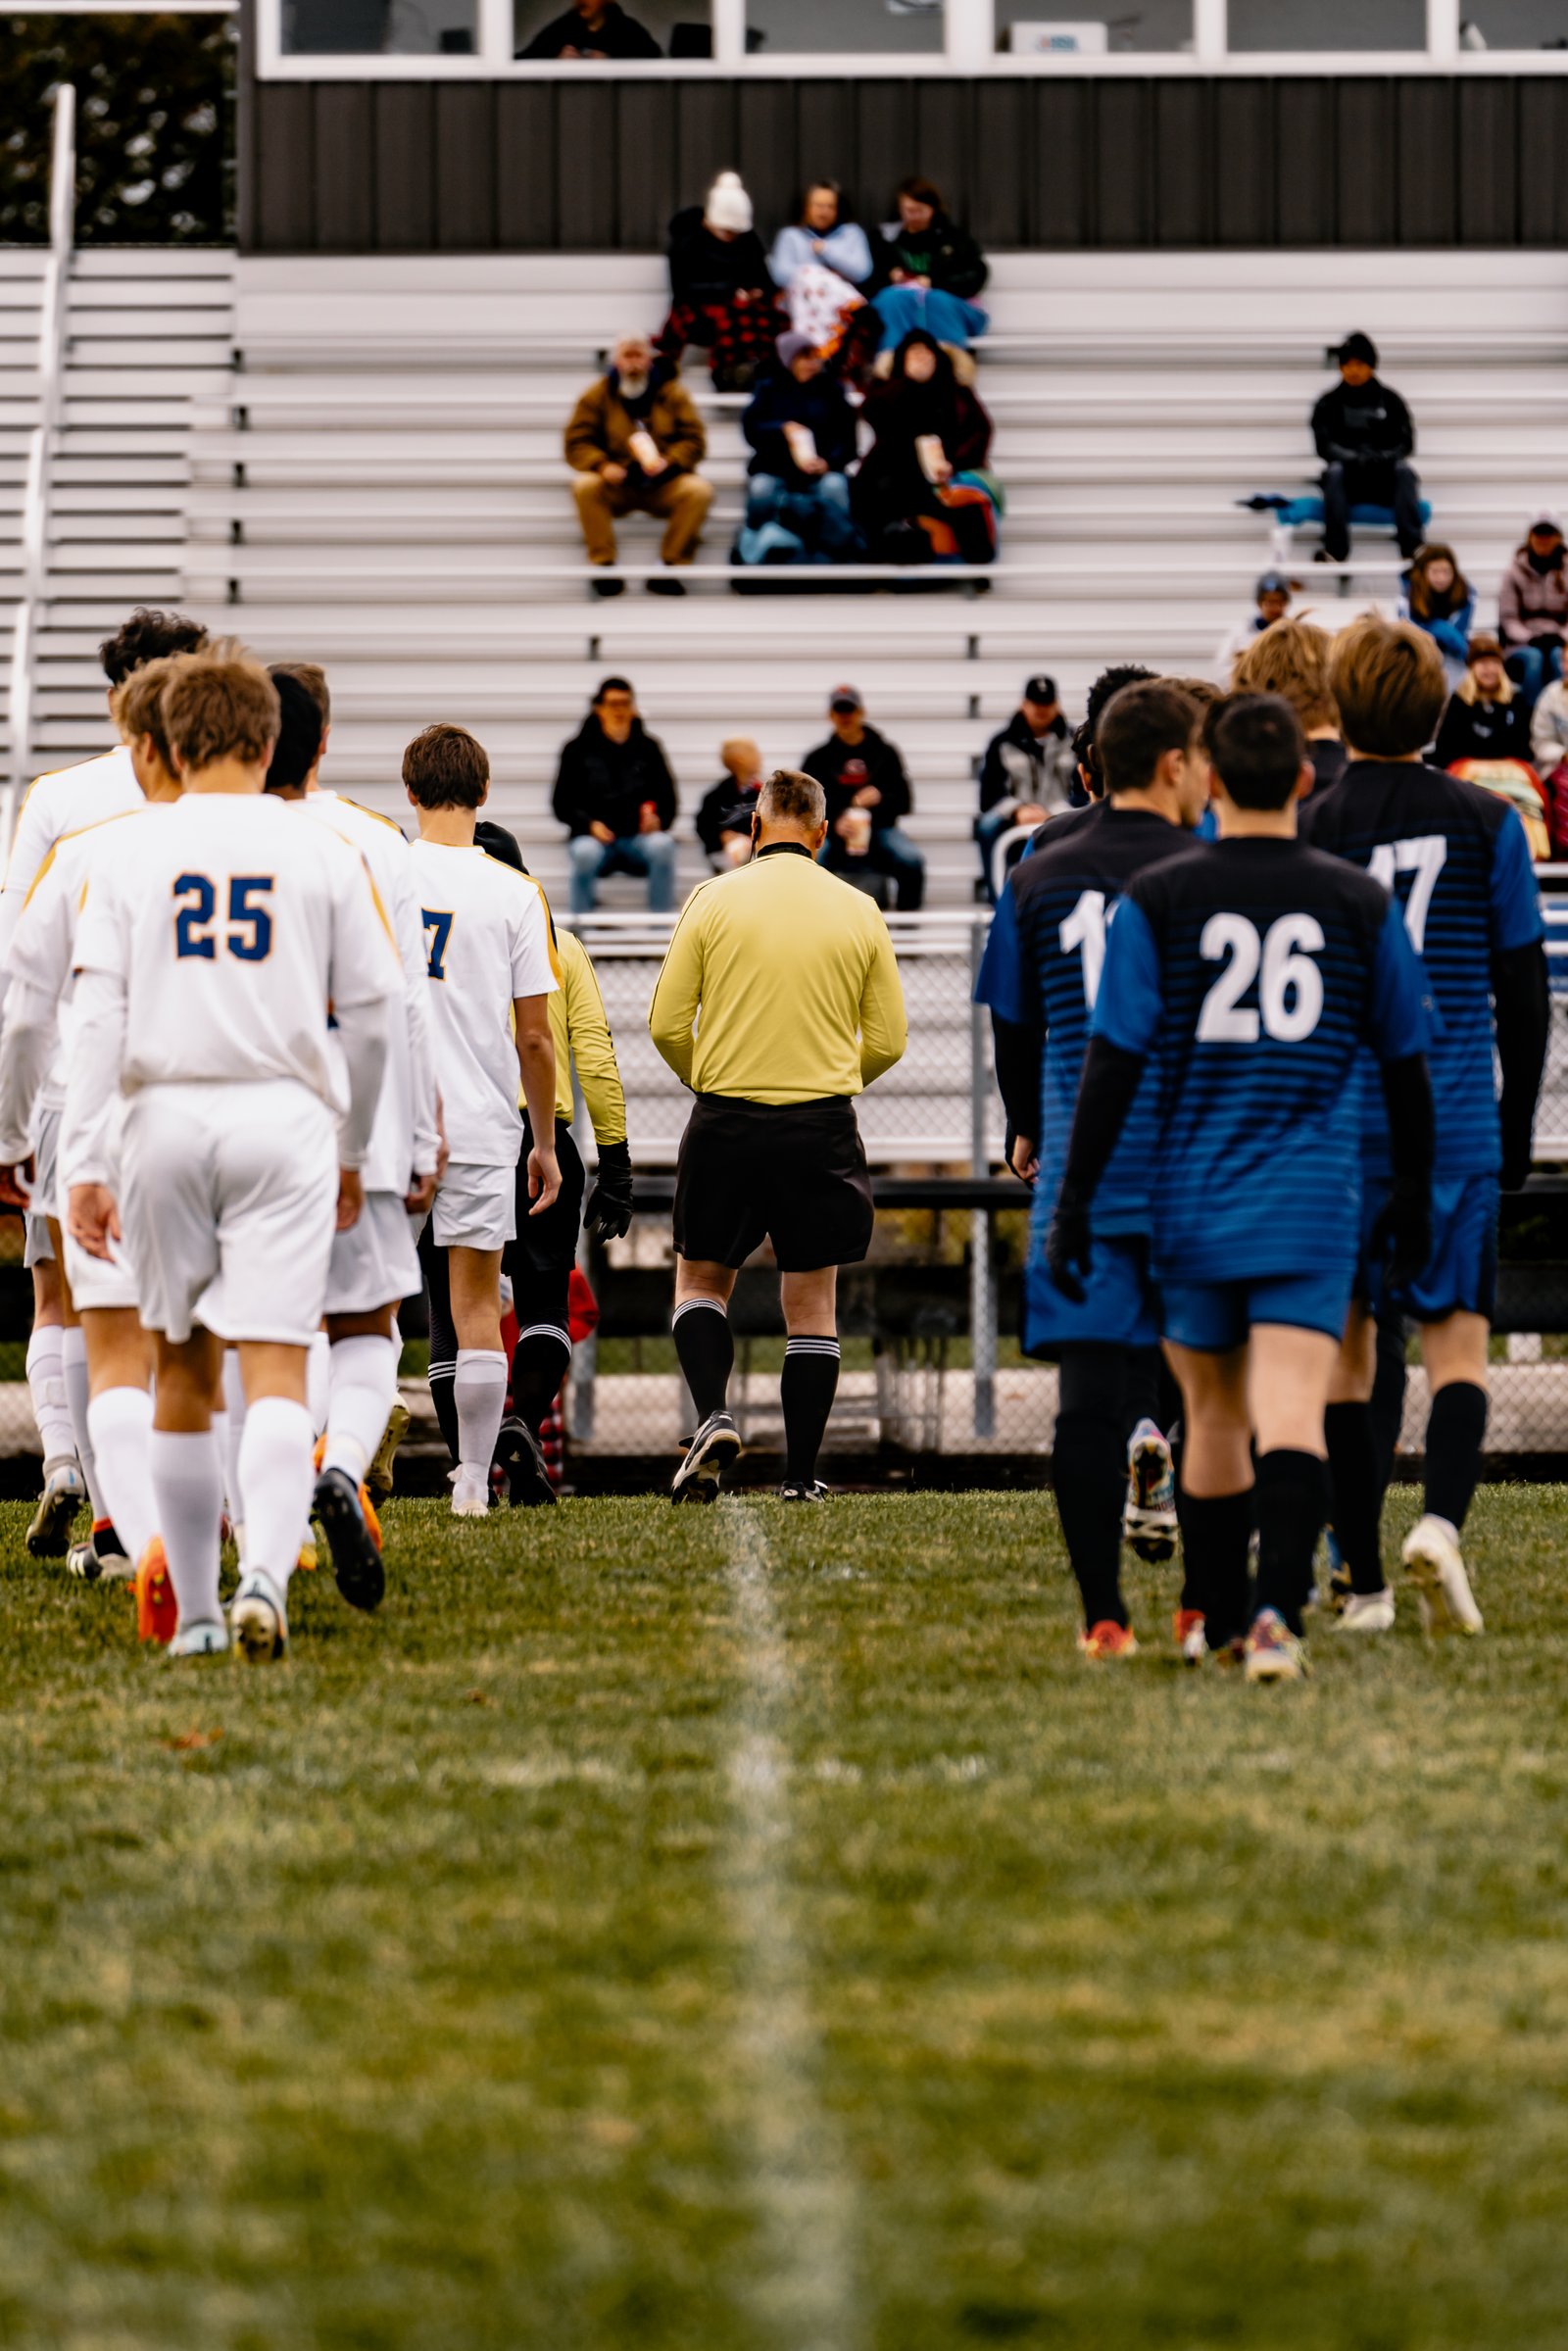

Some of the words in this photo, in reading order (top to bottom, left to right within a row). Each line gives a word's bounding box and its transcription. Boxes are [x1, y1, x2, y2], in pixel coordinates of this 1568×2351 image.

[172, 872, 275, 962] 25
[1059, 889, 1121, 1012] 1
[1195, 911, 1326, 1044] 26
